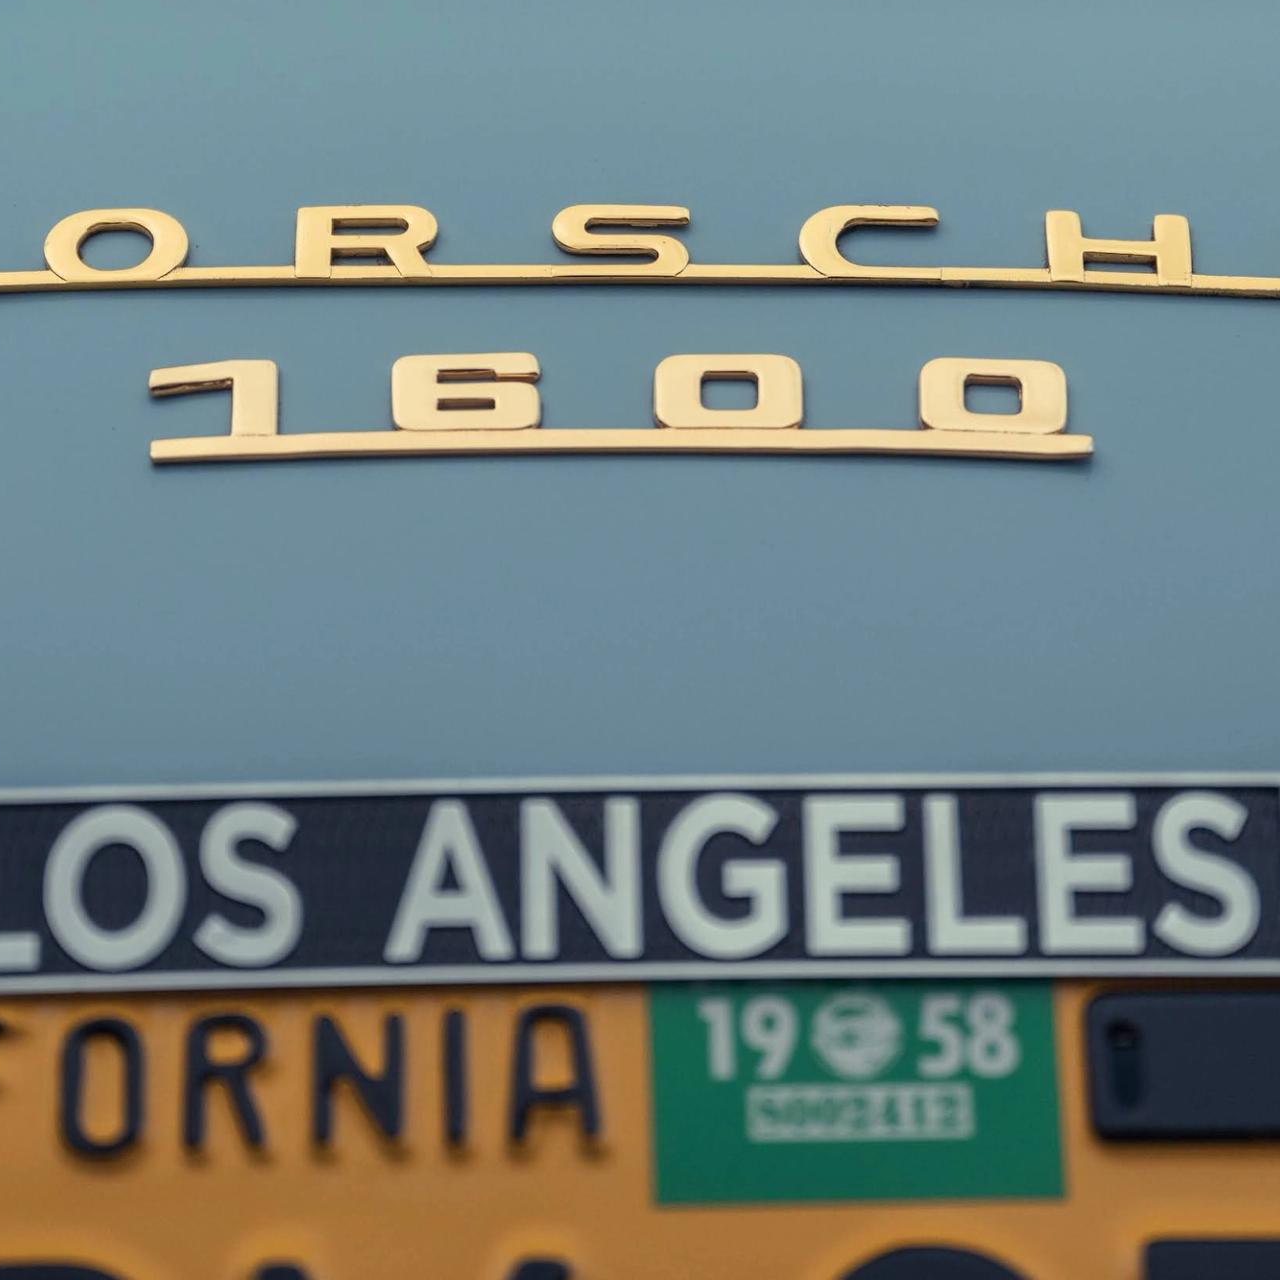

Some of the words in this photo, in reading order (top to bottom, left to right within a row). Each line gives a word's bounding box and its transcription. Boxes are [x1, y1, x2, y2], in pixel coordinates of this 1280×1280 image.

[149, 351, 1070, 442] 1600
[383, 791, 1261, 962] ANGELES
[697, 993, 800, 1081] 19
[917, 991, 1021, 1078] 58
